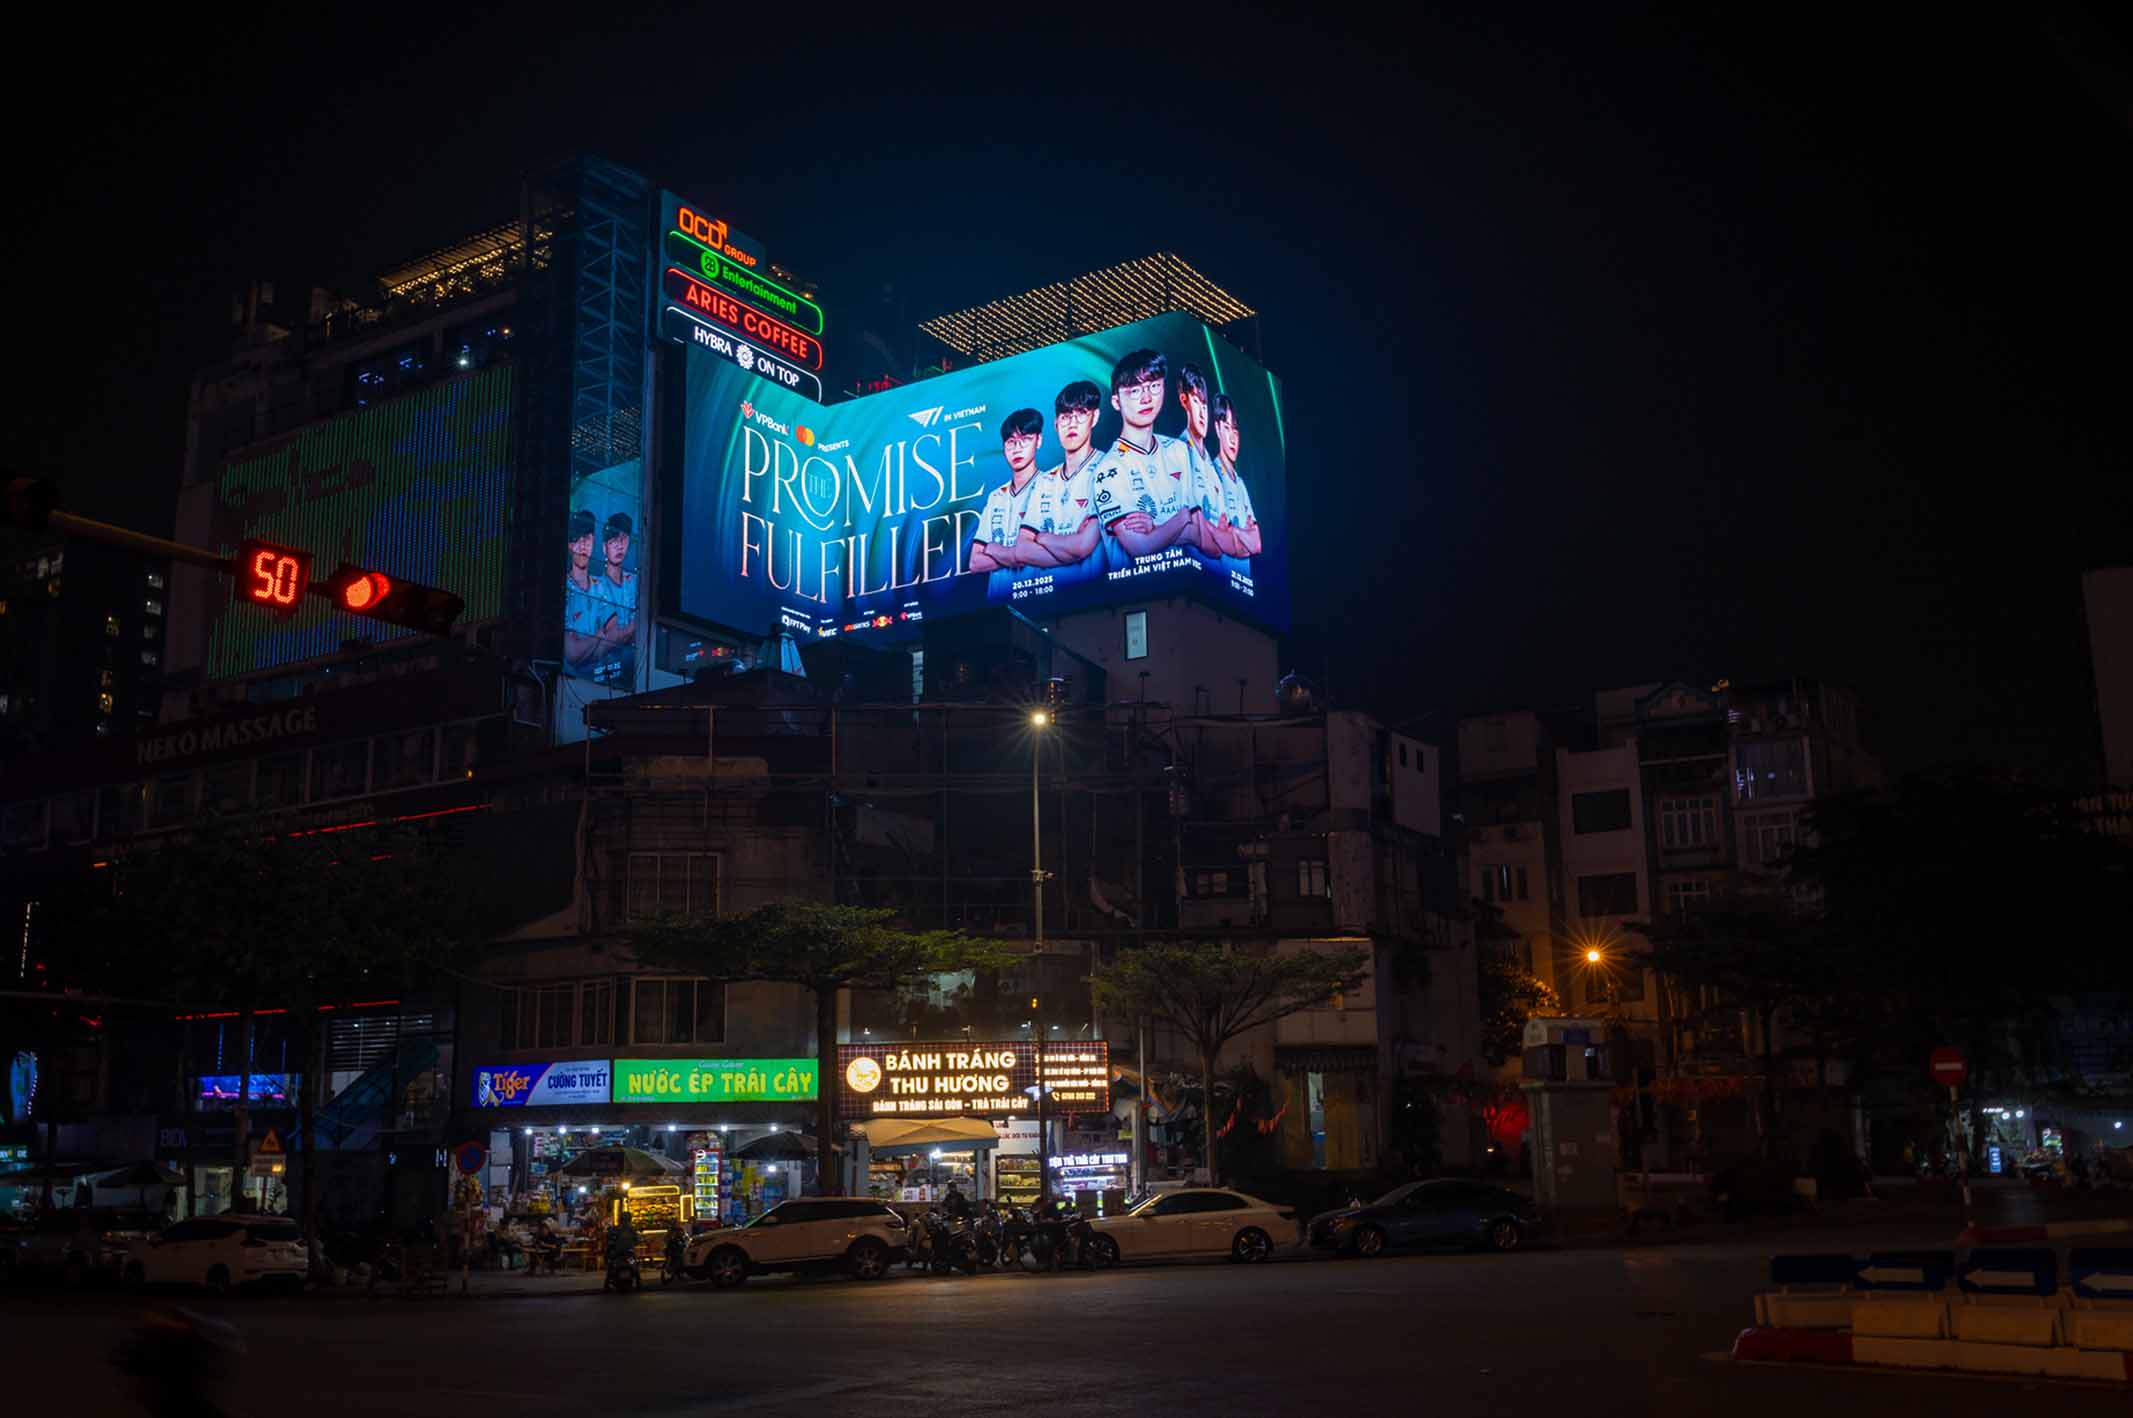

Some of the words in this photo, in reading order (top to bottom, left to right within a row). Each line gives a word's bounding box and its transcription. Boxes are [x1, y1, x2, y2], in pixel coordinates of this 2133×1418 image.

[724, 244, 757, 267] GROUP
[722, 266, 797, 315] Entertainment
[685, 284, 738, 324] ARIES
[743, 313, 808, 361] COFFEE
[693, 326, 733, 357] HYBRA
[757, 357, 775, 377] ON
[776, 365, 800, 387] TOP
[755, 410, 789, 436] VPBank
[953, 404, 986, 420] VIETNAM
[741, 421, 985, 532] PROMISE
[1135, 553, 1163, 566] TRUNG
[1173, 557, 1191, 568] NAM
[254, 551, 298, 604] 50
[200, 704, 318, 752] MASSAGE
[885, 1050, 941, 1071] BÁNH
[945, 1048, 1016, 1069] TRÁNG
[493, 1070, 530, 1099] Tiger
[579, 1068, 608, 1088] TUYẾT
[628, 1068, 681, 1094] NƯỚC
[688, 1067, 714, 1093] ÉP
[721, 1067, 767, 1093] TRÁI
[773, 1066, 813, 1093] CÂY
[890, 1077, 929, 1094] THU
[934, 1074, 1010, 1093] HƯƠNG
